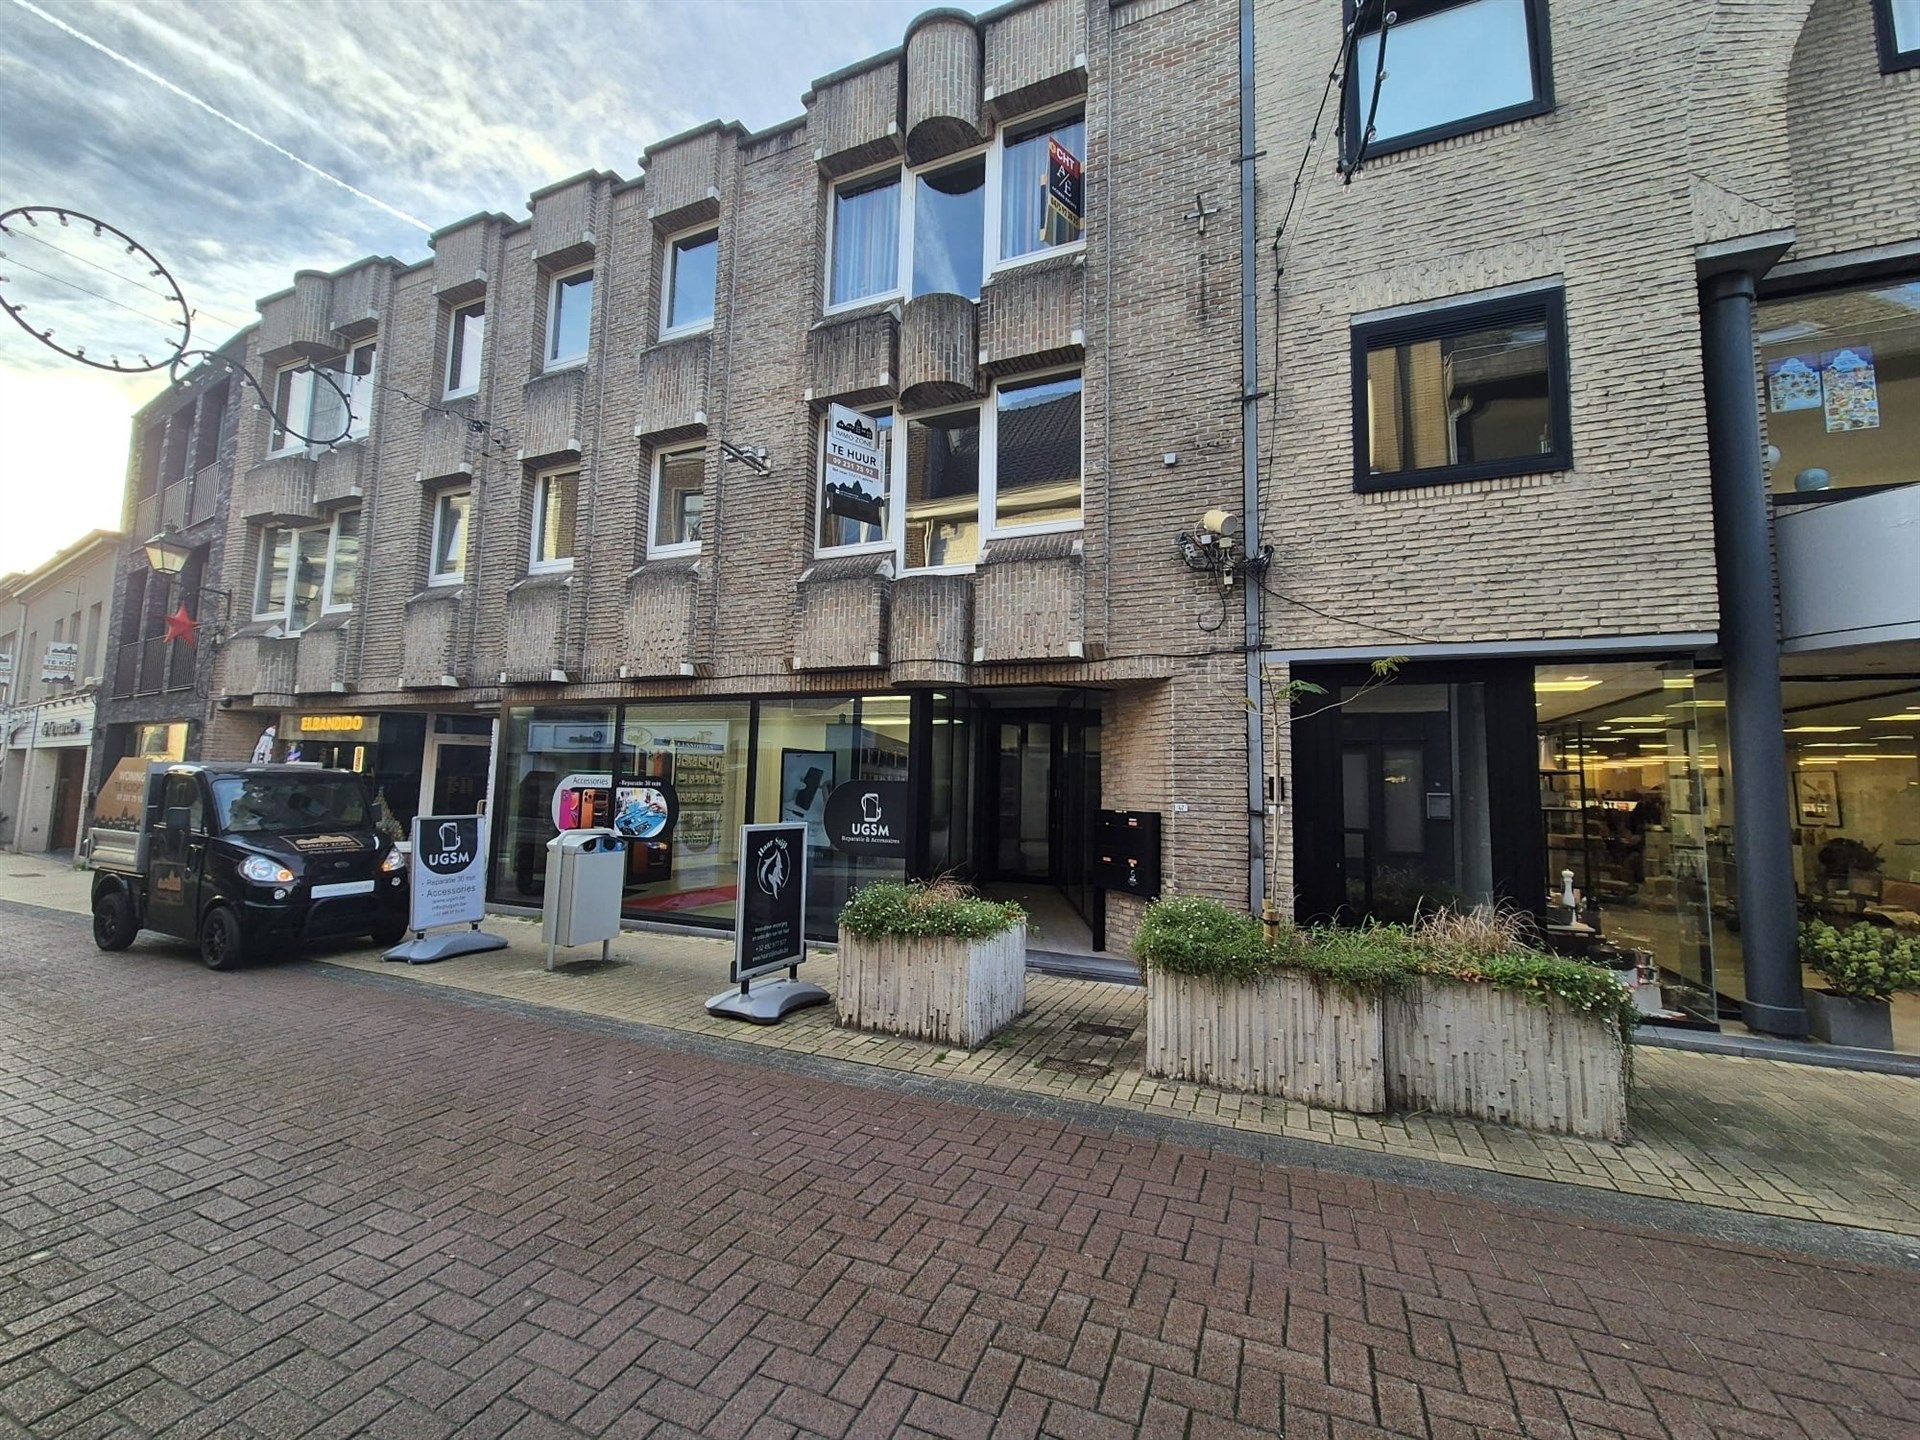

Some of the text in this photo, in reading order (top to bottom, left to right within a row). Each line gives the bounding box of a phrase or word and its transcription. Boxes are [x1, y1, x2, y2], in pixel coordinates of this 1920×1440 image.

[835, 429, 873, 447] IMMO ZONE
[831, 443, 877, 467] TE HUUR
[832, 457, 842, 465] 09
[842, 461, 855, 469] 231
[865, 468, 874, 476] 92
[851, 823, 890, 836] UGSM
[428, 851, 470, 866] UGSM
[426, 884, 477, 898] Accessories
